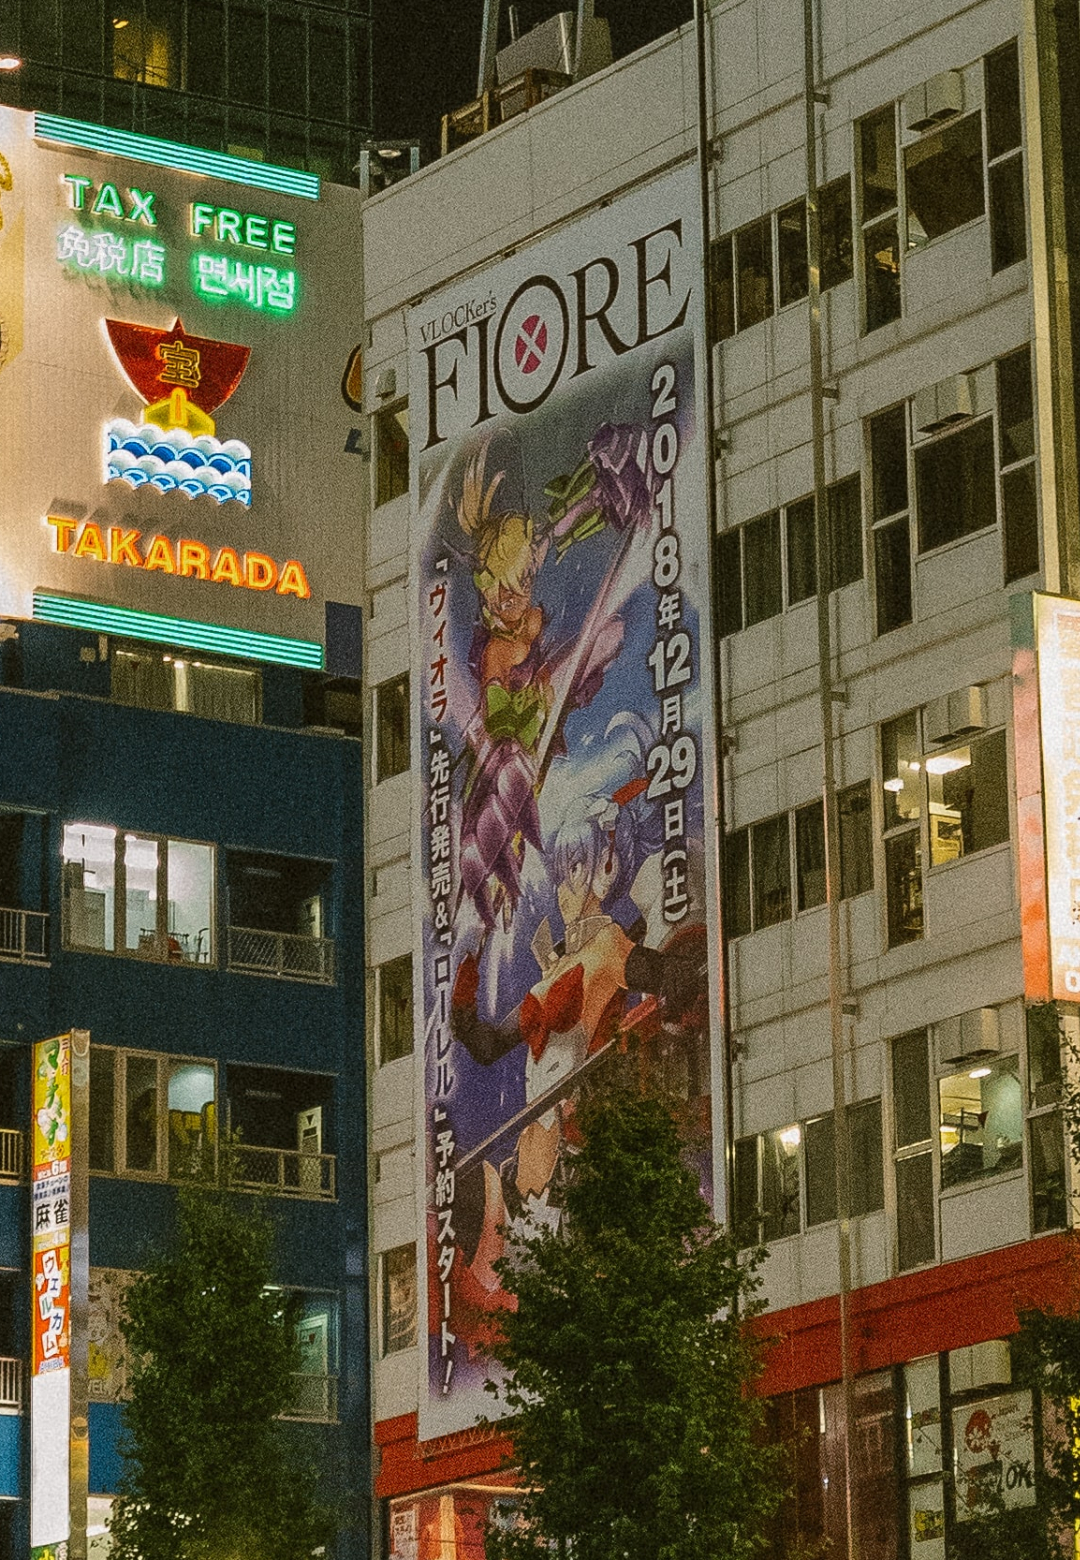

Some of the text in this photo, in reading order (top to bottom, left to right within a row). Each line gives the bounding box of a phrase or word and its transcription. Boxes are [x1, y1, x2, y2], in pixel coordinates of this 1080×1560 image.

[62, 174, 298, 256] TAX FREE
[56, 223, 166, 284] 免税店
[195, 253, 297, 311] 면세점
[418, 218, 693, 453] FIORE
[45, 515, 312, 600] TAKARADA
[35, 1198, 70, 1230] 麻雀
